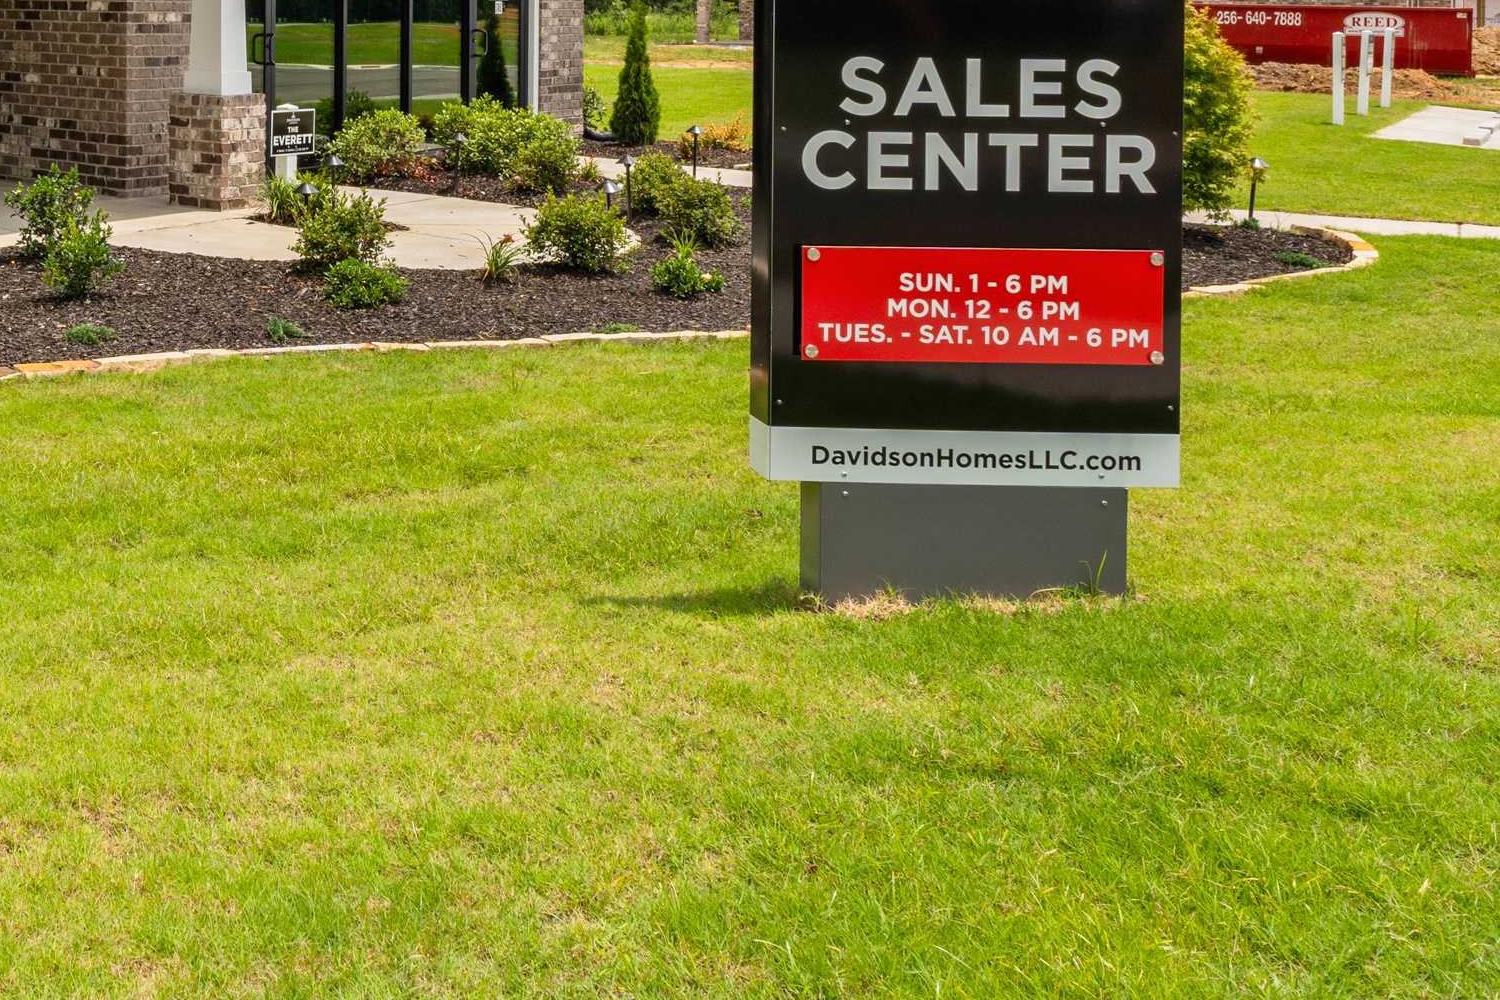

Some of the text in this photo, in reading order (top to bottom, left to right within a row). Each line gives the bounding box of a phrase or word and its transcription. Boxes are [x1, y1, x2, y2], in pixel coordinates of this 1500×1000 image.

[1351, 16, 1398, 28] REED
[839, 55, 1122, 119] SALES
[273, 133, 313, 146] EVERETT
[801, 129, 1157, 194] CENTER
[899, 272, 961, 293] SUN.
[969, 273, 978, 293] 1
[1005, 274, 1021, 294] 6
[1030, 274, 1068, 295] PM
[887, 298, 957, 319] MON.
[964, 299, 991, 319] 12
[1017, 300, 1033, 320] 6
[1042, 301, 1080, 321] PM
[817, 322, 893, 343] TUES.
[919, 324, 973, 345] SAT.
[981, 325, 1010, 346] 10
[1017, 326, 1059, 347] AM
[1086, 327, 1102, 348] 6
[1111, 328, 1150, 349] PM
[811, 445, 1141, 471] DavidsonHomesLLC.com
